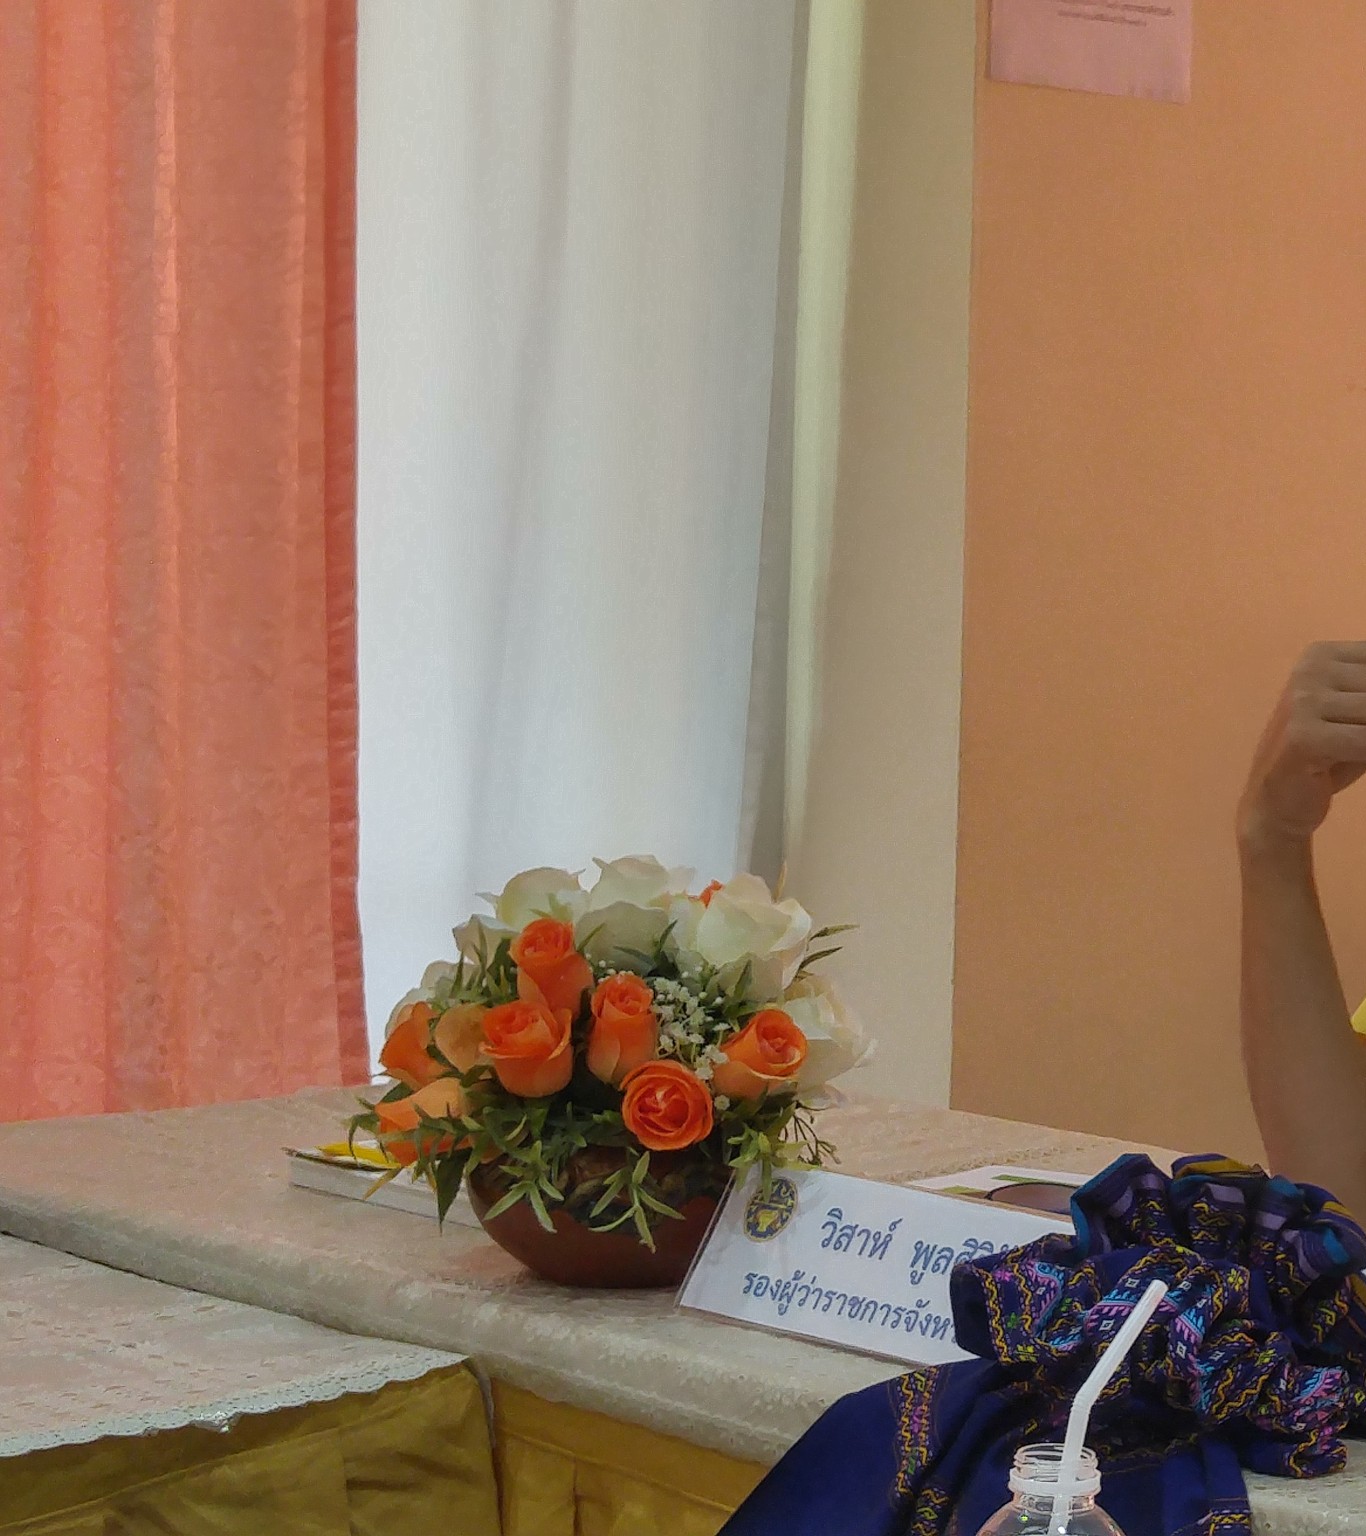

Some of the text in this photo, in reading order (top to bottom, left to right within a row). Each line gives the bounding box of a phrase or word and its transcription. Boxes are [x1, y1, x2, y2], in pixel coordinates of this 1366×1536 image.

[821, 1207, 903, 1261] วิสาห์
[743, 1269, 956, 1344] รองผู้ว่าราชการจังห
